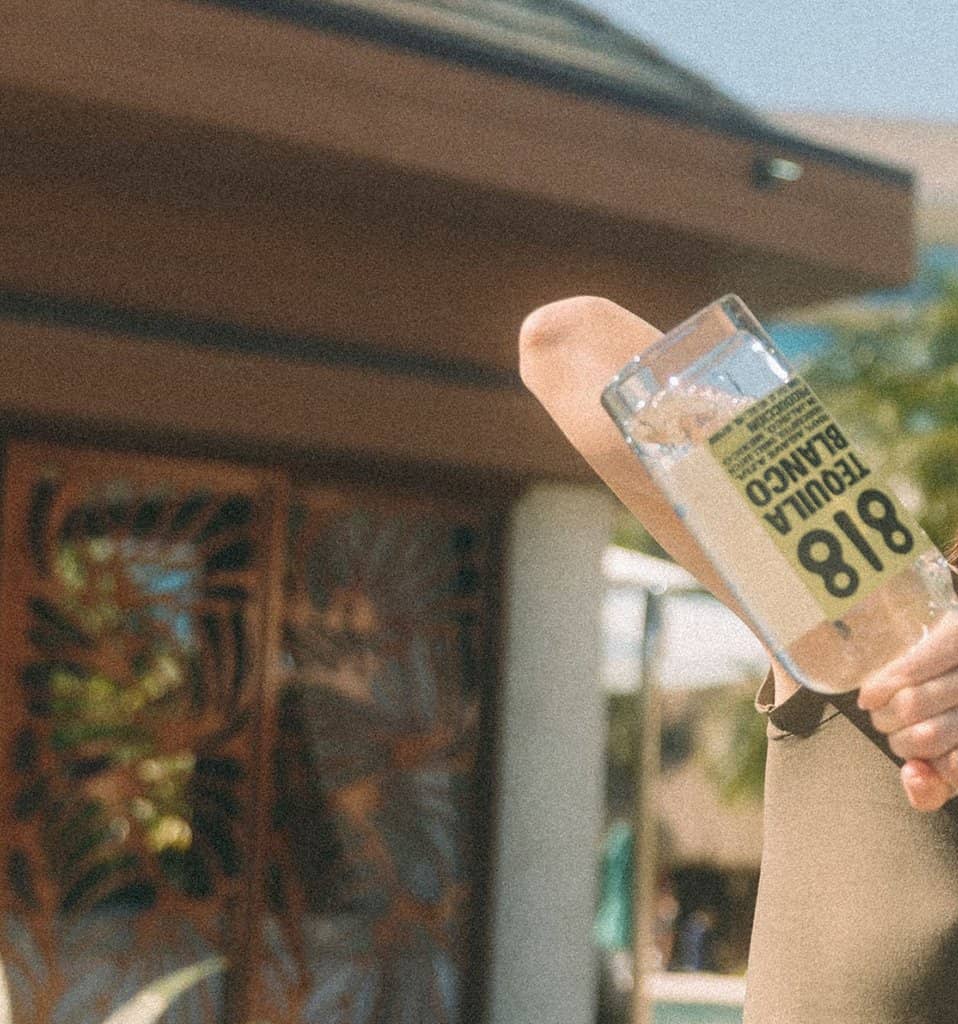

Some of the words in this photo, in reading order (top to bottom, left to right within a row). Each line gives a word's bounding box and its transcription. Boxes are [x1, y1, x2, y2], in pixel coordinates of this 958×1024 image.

[745, 422, 849, 507] BLANCO
[762, 451, 871, 535] TEQUILA
[797, 487, 914, 598] 818
